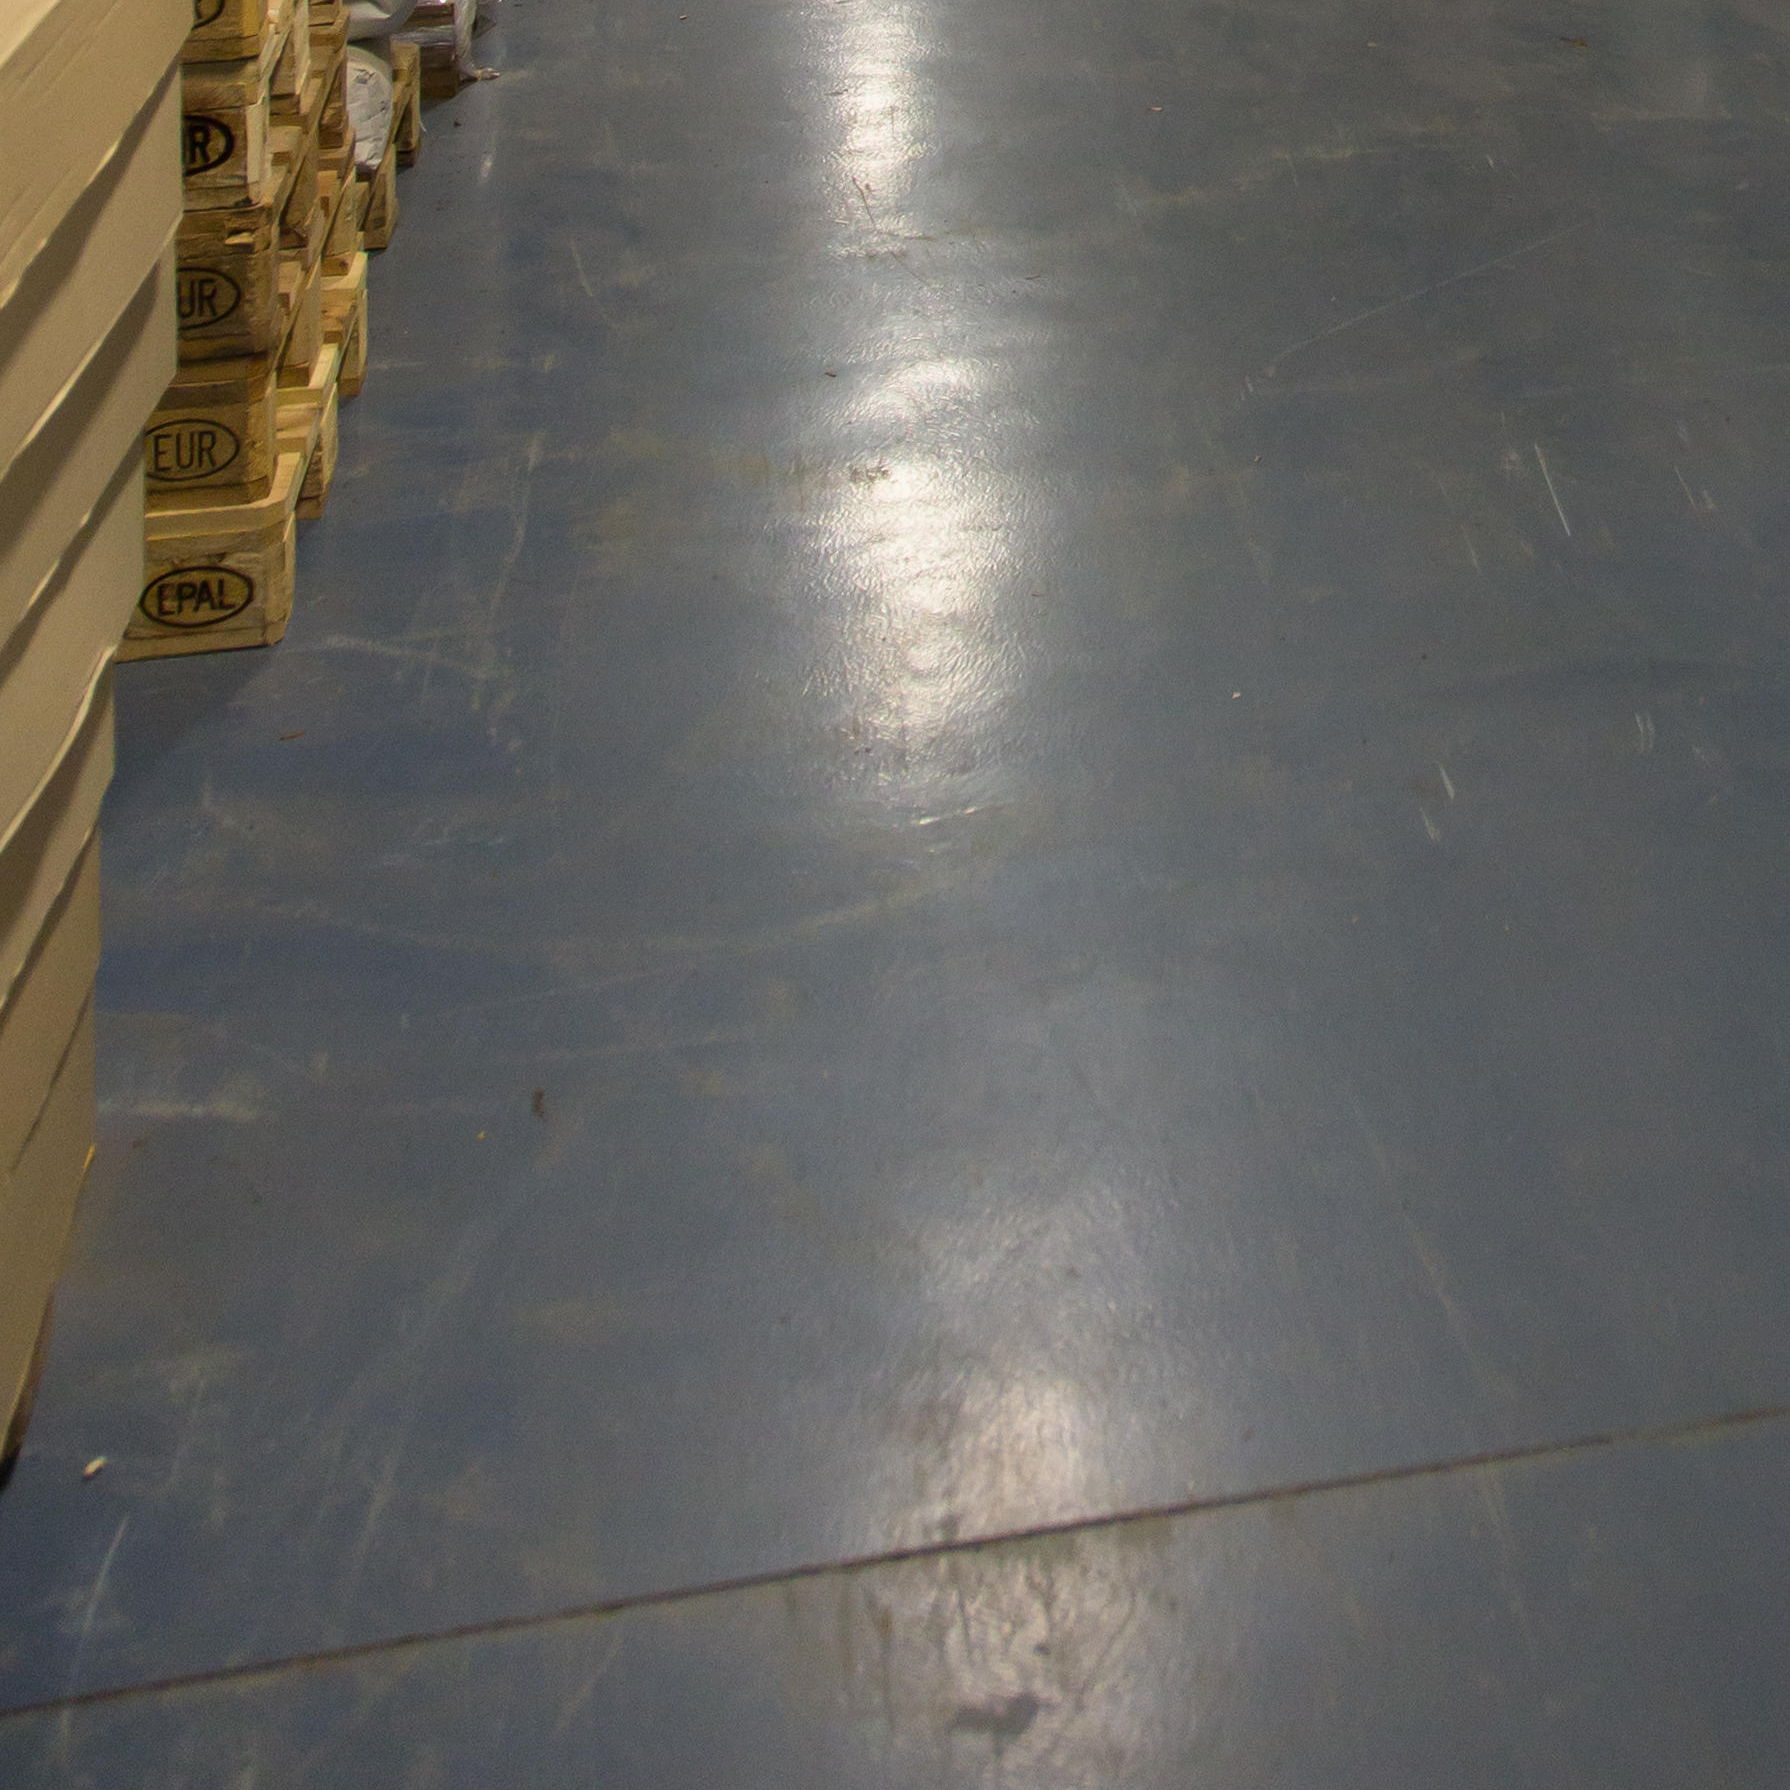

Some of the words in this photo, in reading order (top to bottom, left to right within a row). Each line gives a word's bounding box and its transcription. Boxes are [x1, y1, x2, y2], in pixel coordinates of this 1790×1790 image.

[177, 278, 218, 319] UR
[153, 429, 217, 473] EUR
[156, 578, 237, 617] EPAL
